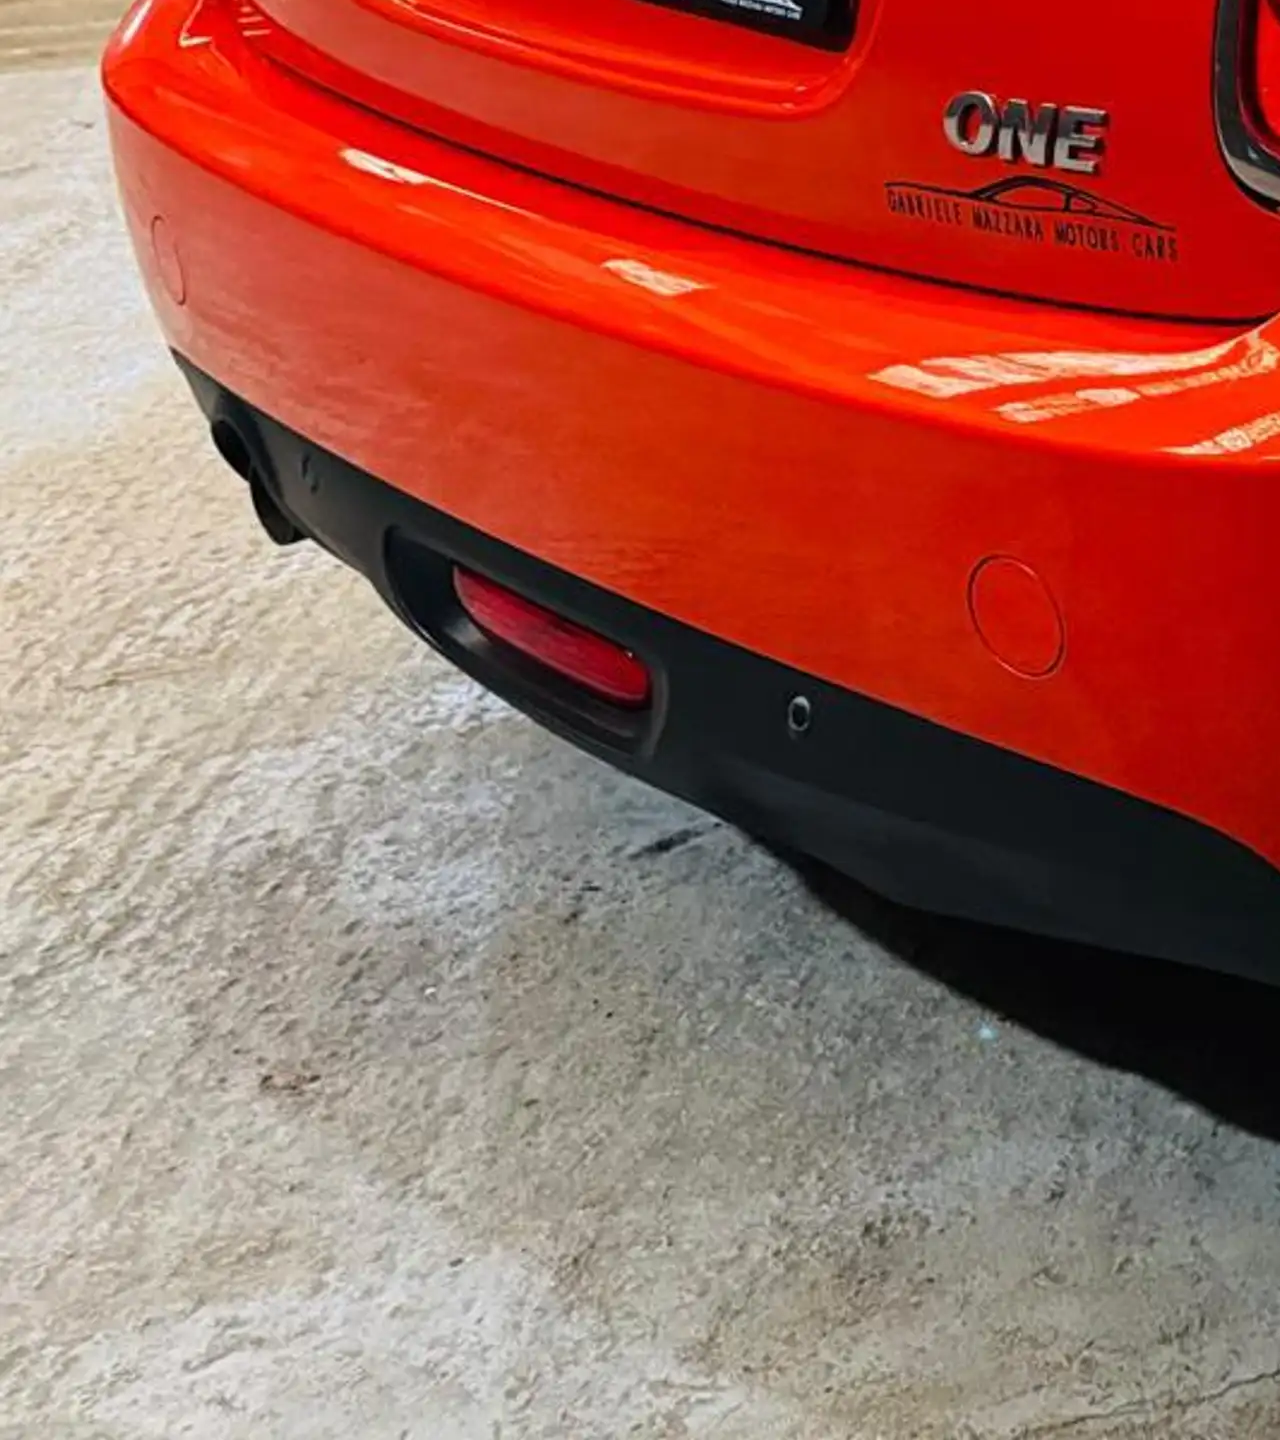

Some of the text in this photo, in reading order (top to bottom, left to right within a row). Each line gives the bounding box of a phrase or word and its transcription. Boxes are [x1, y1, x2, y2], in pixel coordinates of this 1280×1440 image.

[943, 90, 1108, 174] ONE
[887, 190, 1179, 262] GABRIELE MAZZARA MOTORS CARS
